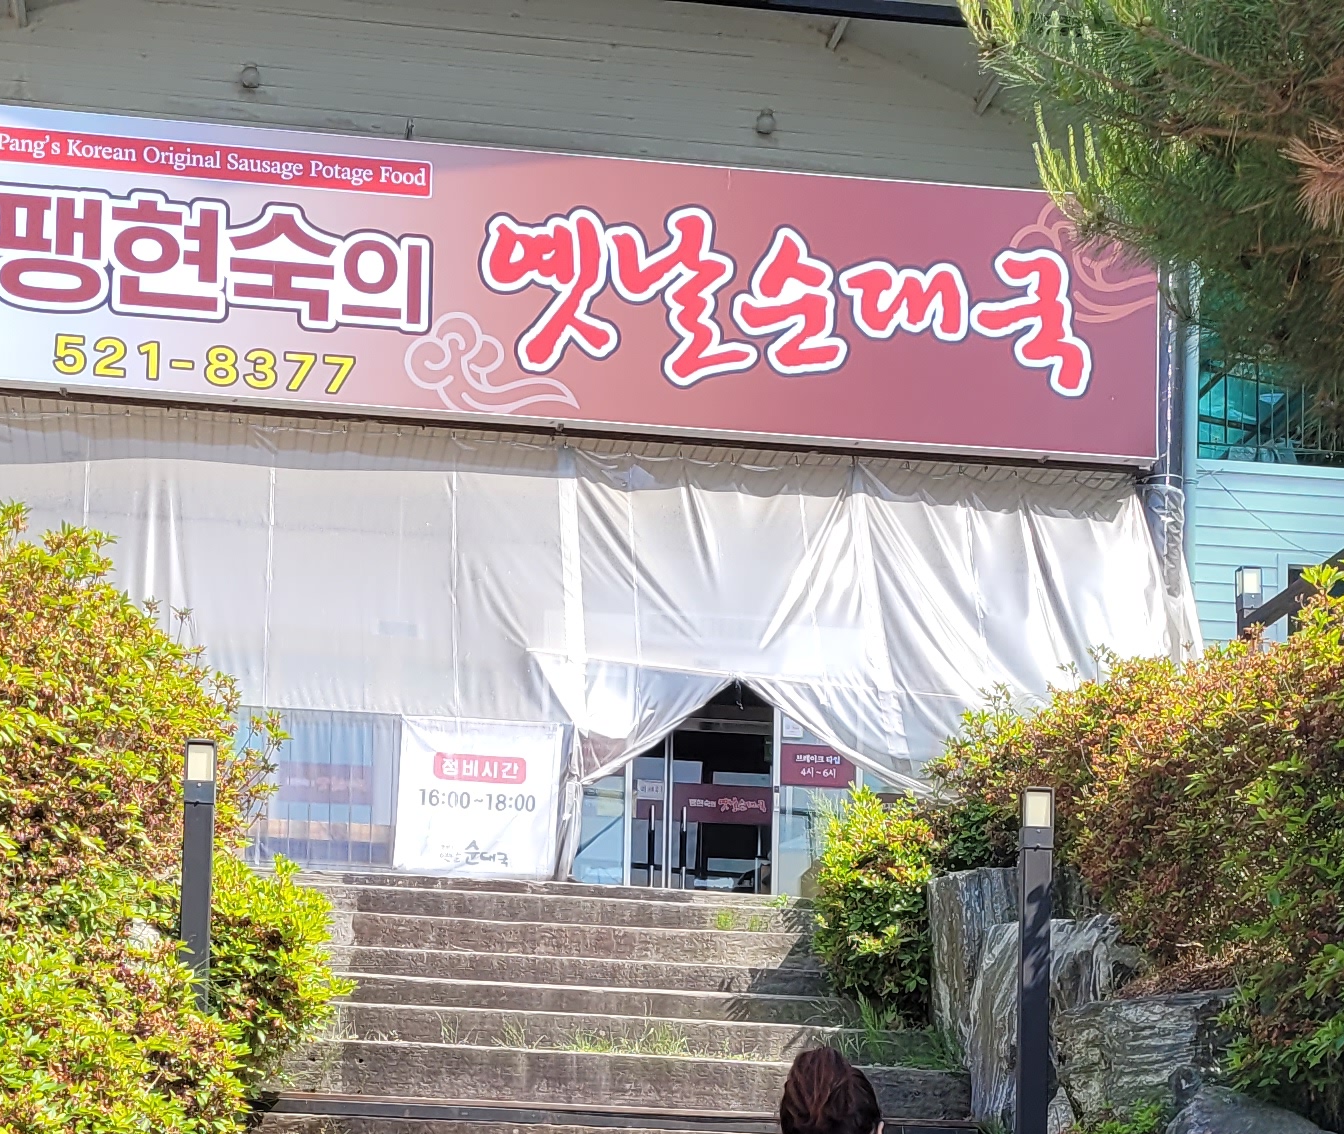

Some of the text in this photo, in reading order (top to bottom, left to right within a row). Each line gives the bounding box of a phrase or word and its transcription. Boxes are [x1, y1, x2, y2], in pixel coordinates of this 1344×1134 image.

[67, 138, 137, 162] Korean
[143, 146, 221, 171] Original
[227, 153, 304, 180] Sausage
[309, 160, 374, 186] Potage
[379, 165, 427, 187] Food
[53, 333, 357, 394] 521-8377
[795, 754, 825, 764] 브레이크
